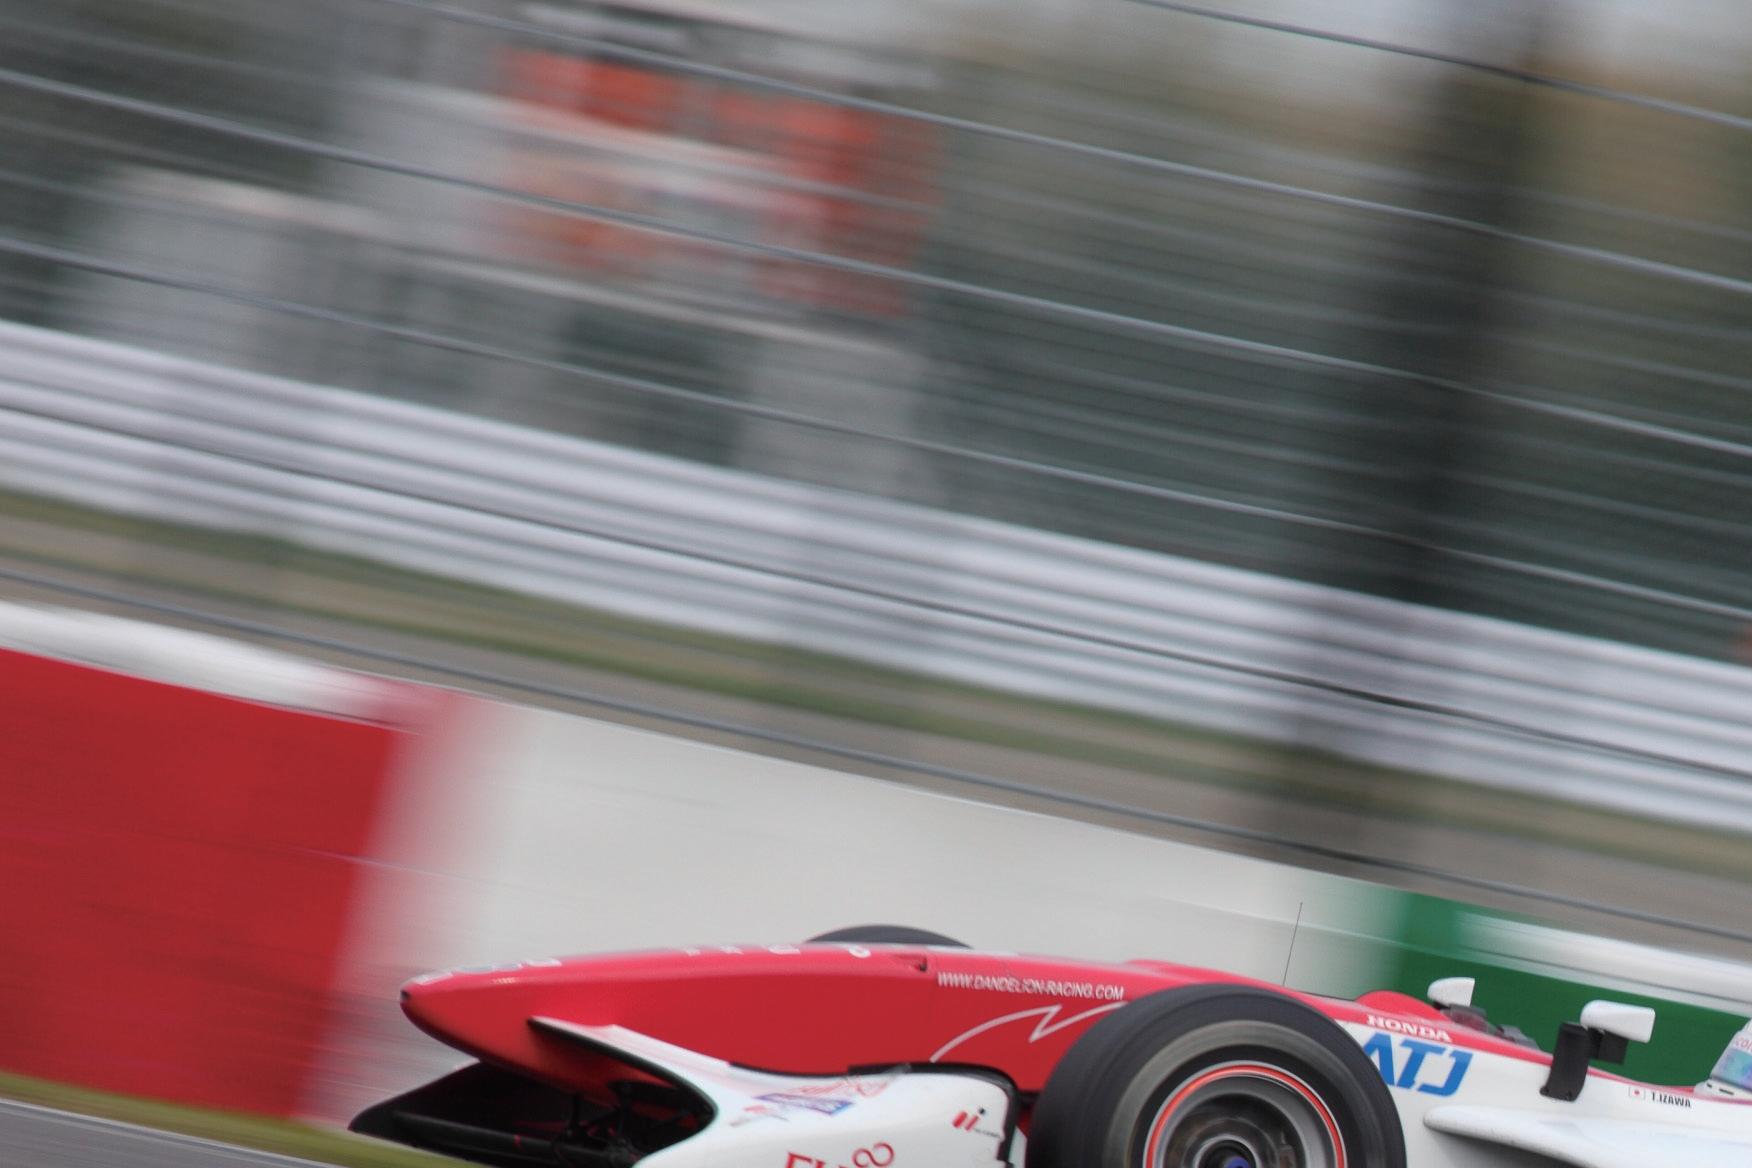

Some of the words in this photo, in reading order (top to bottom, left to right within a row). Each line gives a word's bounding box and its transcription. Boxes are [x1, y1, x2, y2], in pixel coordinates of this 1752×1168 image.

[937, 971, 1125, 1001] WWW.DANDELION-RACING.COM
[1365, 1013, 1453, 1043] HONDA
[1363, 1031, 1473, 1098] ATJ
